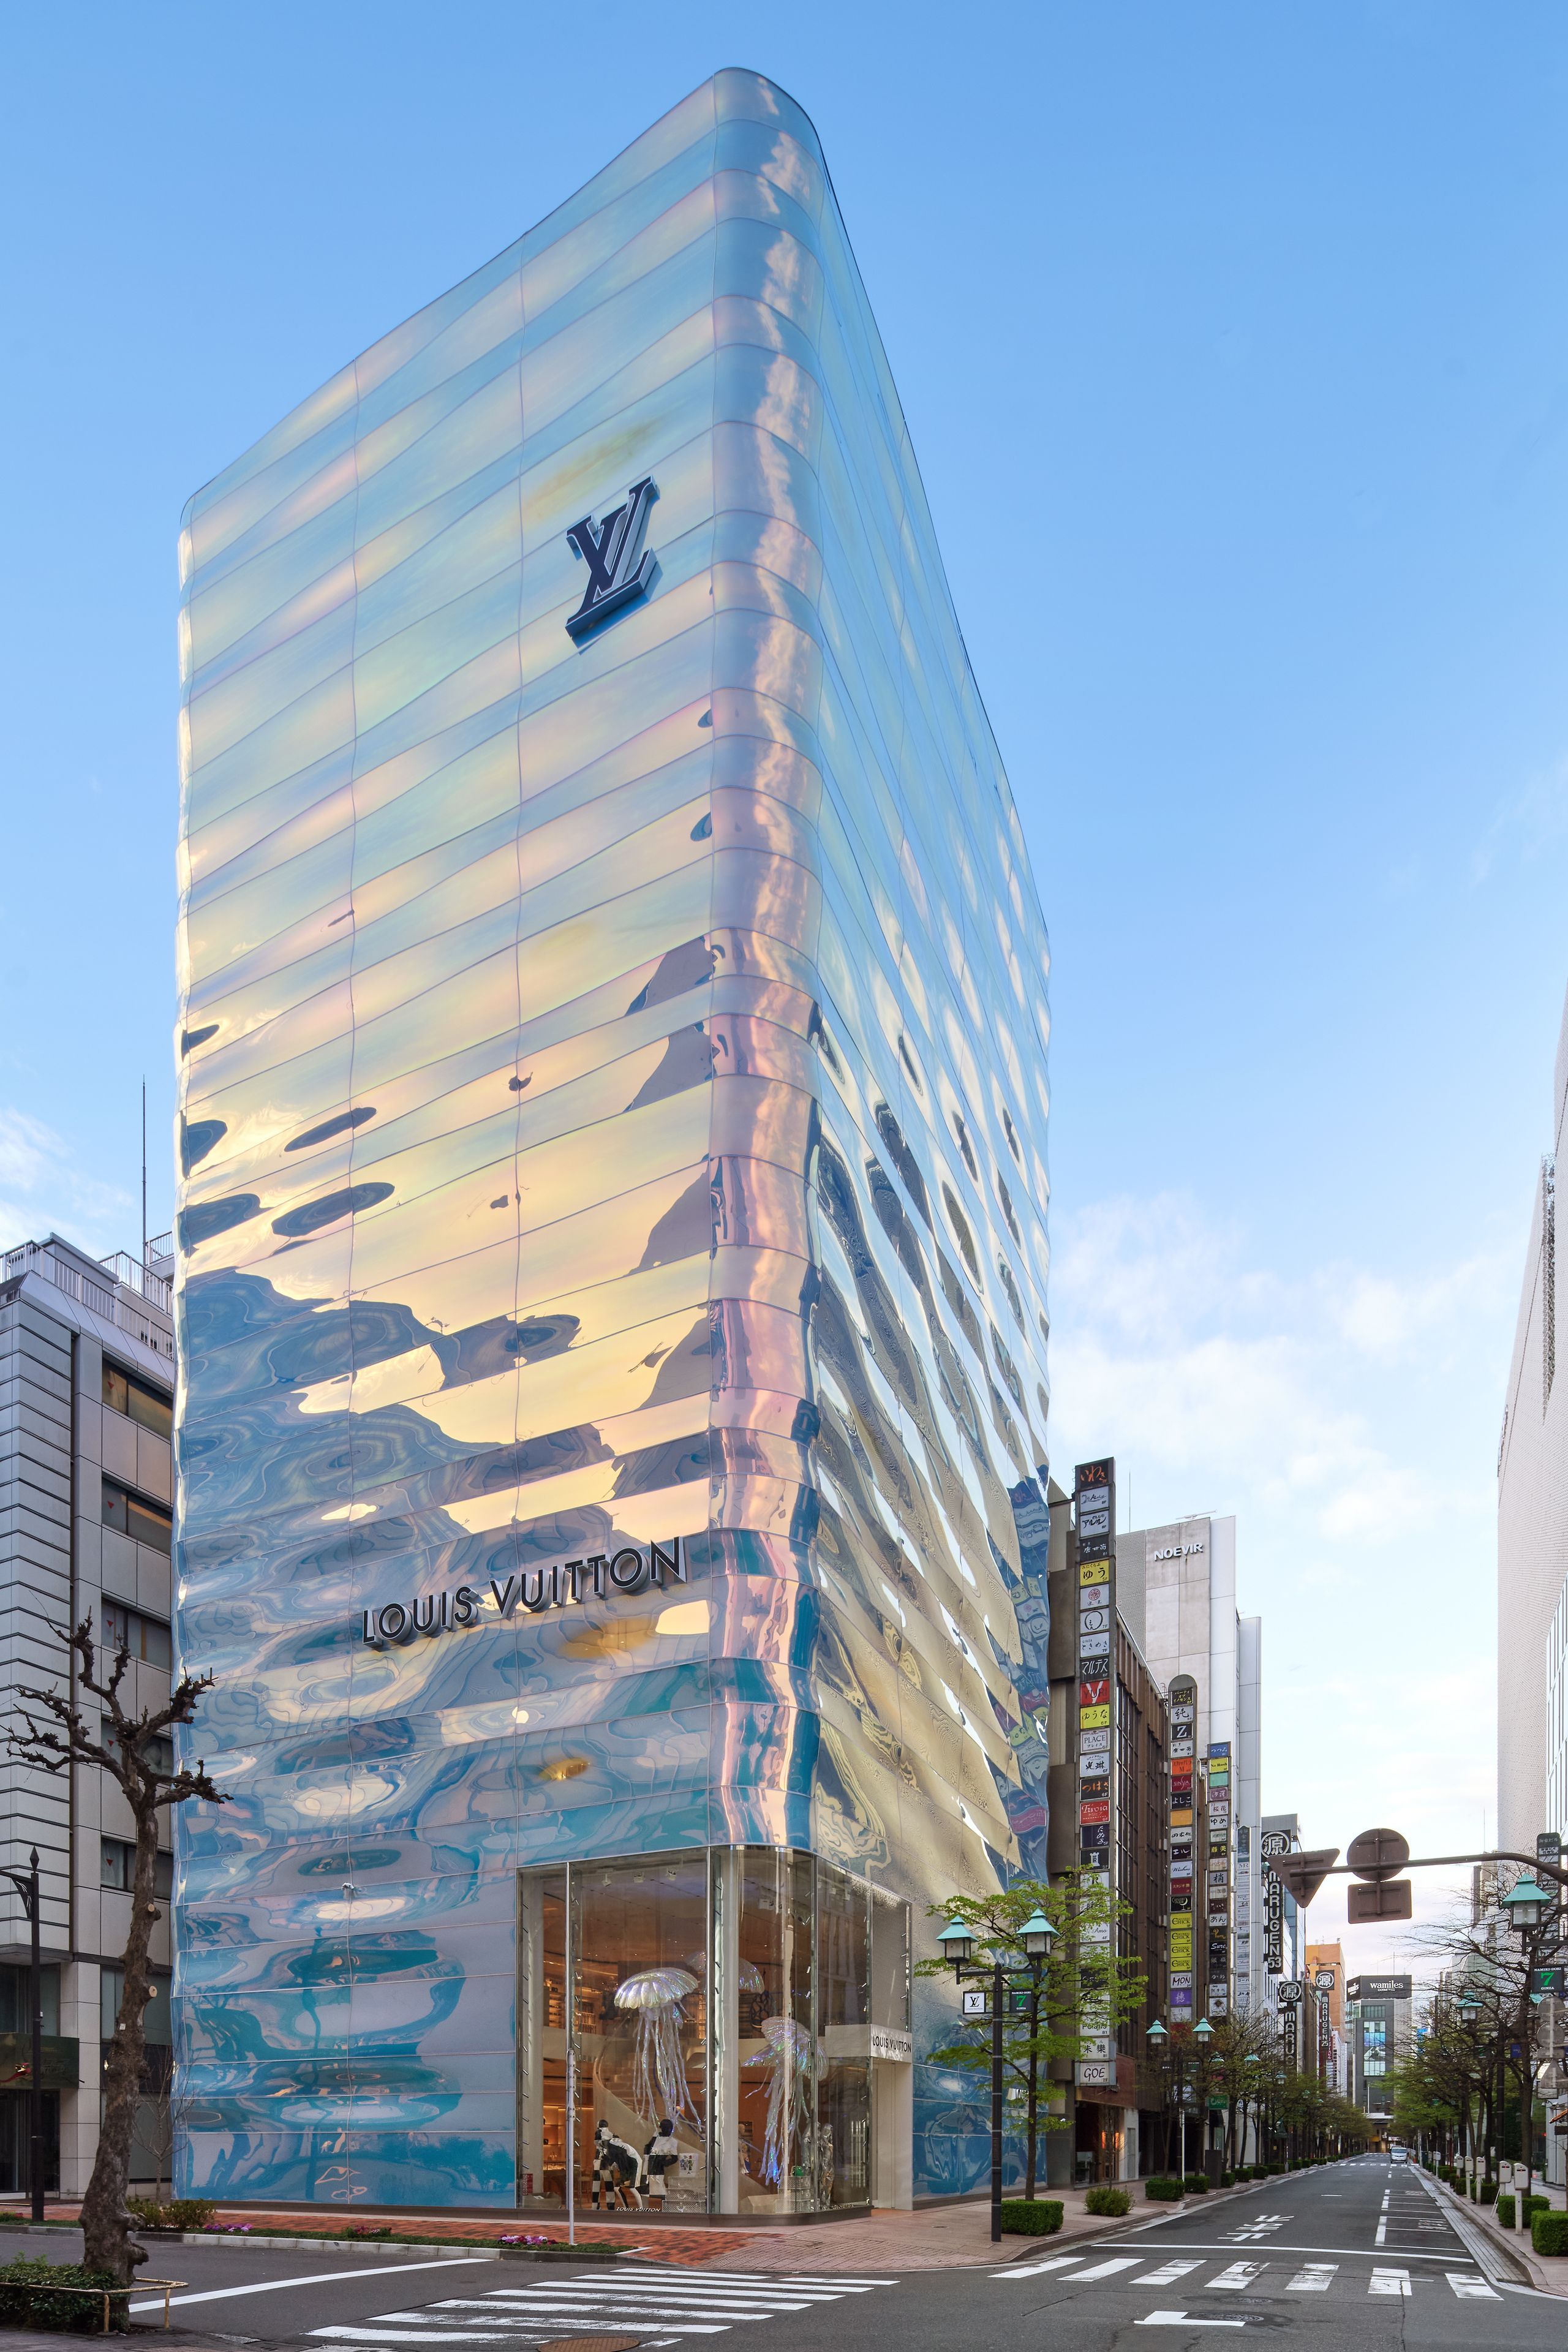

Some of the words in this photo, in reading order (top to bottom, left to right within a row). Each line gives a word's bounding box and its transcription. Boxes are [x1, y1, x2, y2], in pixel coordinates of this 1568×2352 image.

[565, 475, 659, 640] LV
[1154, 1543, 1203, 1561] NOEVIR
[1084, 1567, 1106, 1580] ゆう
[363, 1585, 478, 1648] LOUIS
[490, 1536, 687, 1618] VUITTON
[1082, 1659, 1108, 1675] マルテス
[1082, 1709, 1107, 1720] ゆうな
[1177, 1725, 1187, 1738] Z
[1084, 1735, 1106, 1744] PLACE
[1263, 1836, 1284, 1855] 源
[1269, 1871, 1281, 1956] MARUGEN
[1267, 1957, 1281, 1968] 53
[1173, 1977, 1191, 1986] MON
[1318, 1974, 1331, 1986] 源
[1540, 1972, 1555, 1986] 7
[1283, 1984, 1297, 1999] 源
[970, 1996, 980, 2007] LV
[1017, 1996, 1027, 2007] 7
[873, 2035, 889, 2048] LOUIS
[890, 2039, 911, 2052] VUITTON
[1084, 2068, 1106, 2082] GOE
